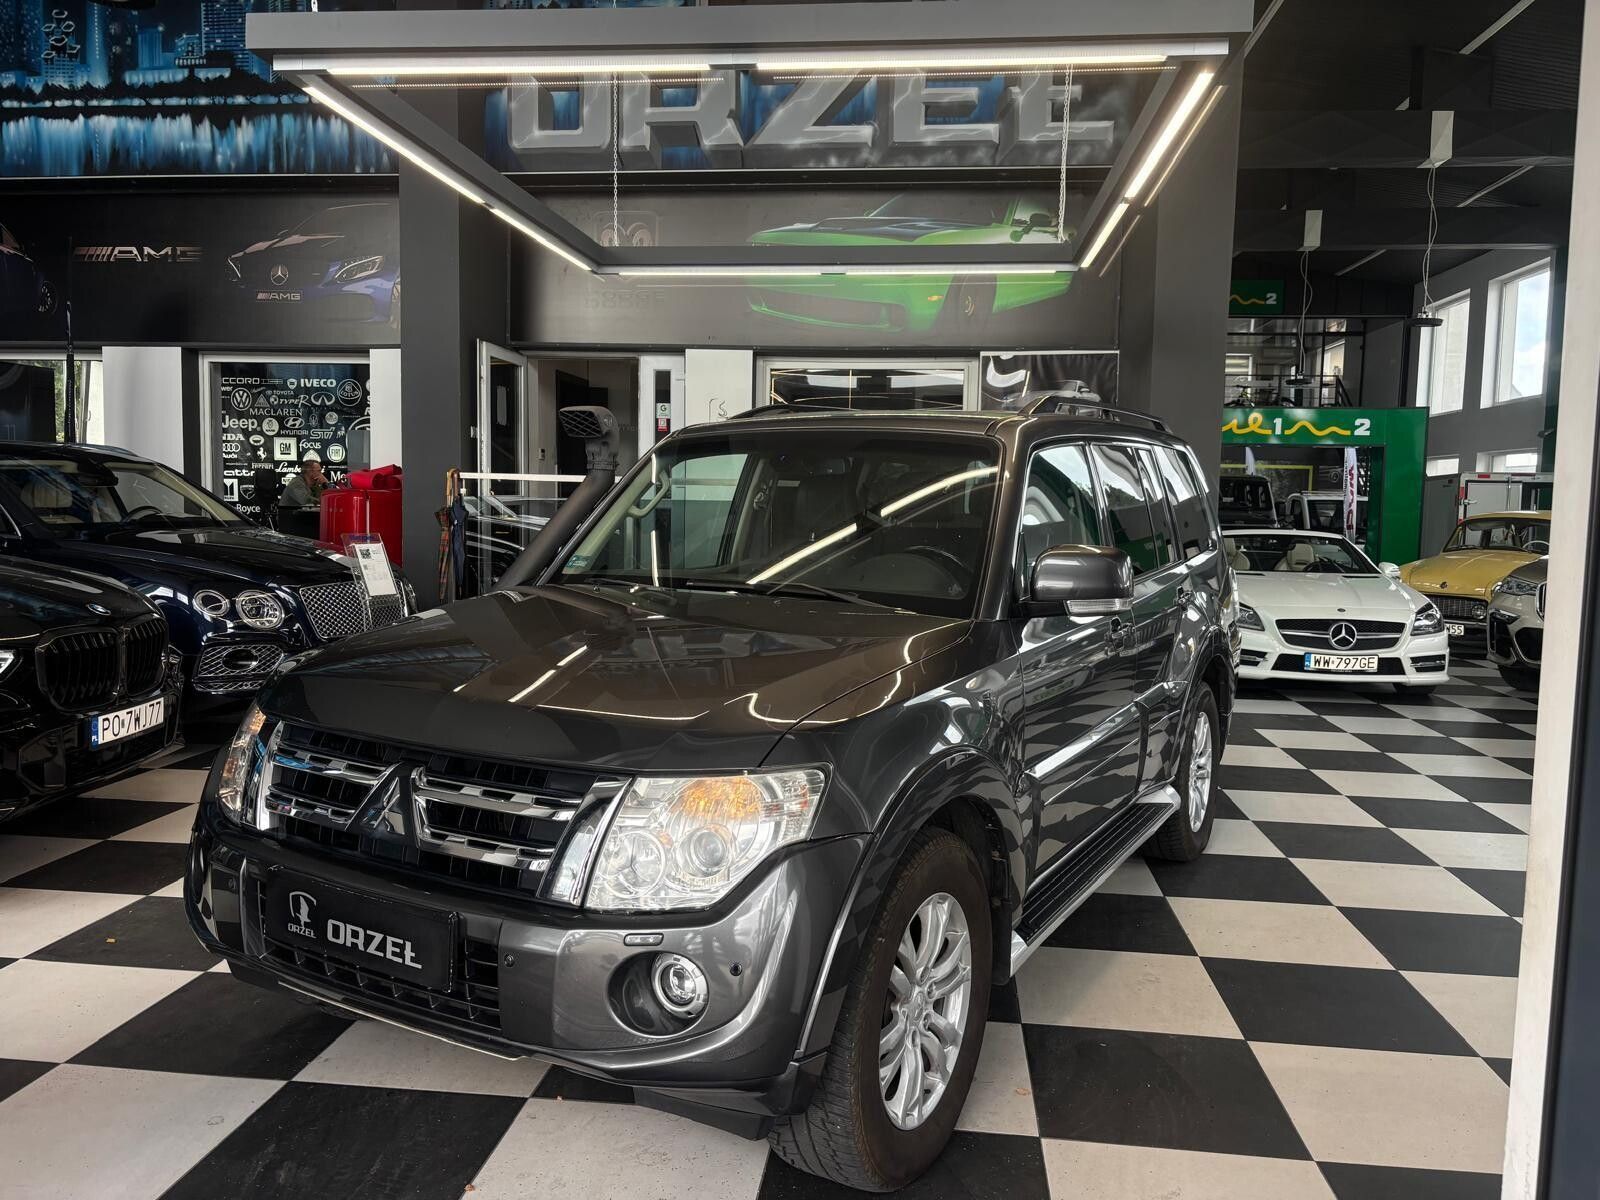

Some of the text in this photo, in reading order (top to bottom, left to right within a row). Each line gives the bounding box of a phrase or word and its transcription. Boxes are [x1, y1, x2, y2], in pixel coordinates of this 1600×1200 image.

[269, 293, 301, 301] AMG
[1265, 293, 1277, 305] 2
[300, 378, 337, 388] IVECO
[249, 408, 303, 417] MACLAREN
[221, 414, 258, 431] Jeep
[1354, 418, 1371, 436] 2
[279, 442, 292, 452] GM
[236, 503, 261, 515] Royce
[1313, 655, 1376, 669] WW 797GE
[102, 701, 161, 742] PO 7WJ77
[287, 922, 317, 939] ORZEŁ
[327, 918, 423, 970] ORZEŁ
